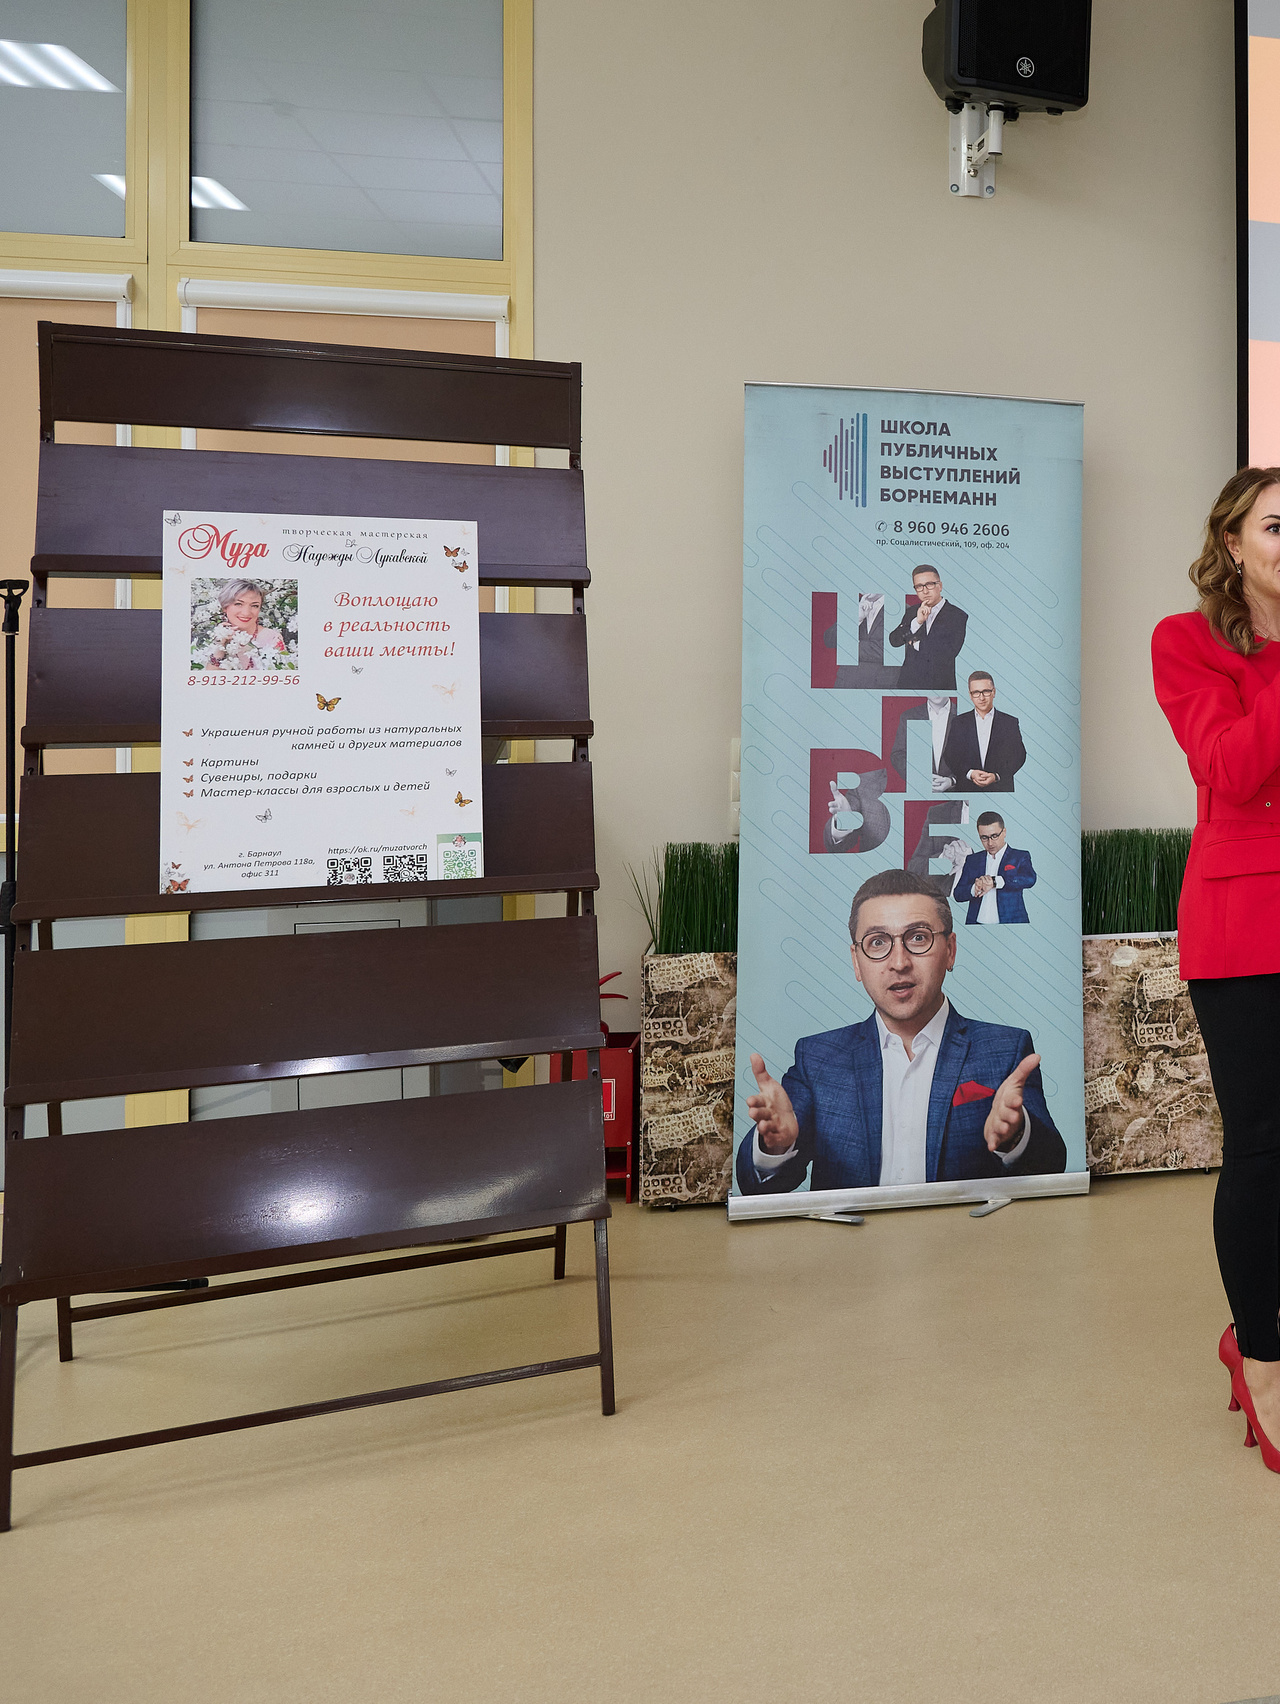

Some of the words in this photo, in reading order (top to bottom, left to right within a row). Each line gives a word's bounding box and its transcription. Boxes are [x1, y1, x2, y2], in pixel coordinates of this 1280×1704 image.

[880, 419, 952, 437] ШКОЛА
[880, 442, 998, 462] ПУБЛИЧНЫХ
[880, 465, 1021, 485] ВЫСТУПЛЕНИЙ
[880, 488, 997, 507] БОРНЕМАНН
[282, 528, 352, 537] творческая
[360, 530, 428, 540] мастерская
[893, 520, 903, 533] 8
[908, 521, 936, 534] 960
[941, 522, 969, 535] 946
[972, 523, 1010, 536] 2606
[178, 523, 269, 568] Муза
[980, 541, 994, 549] оф.
[282, 543, 353, 567] Надежды
[356, 546, 429, 568] Лукавской
[333, 591, 438, 611] Воплощаю
[324, 621, 333, 632] в
[338, 620, 451, 638] реальность
[324, 645, 374, 658] ваши
[379, 642, 455, 658] мечты!
[187, 674, 301, 687] 8-913-212-99-56
[200, 728, 269, 739] Украшения
[272, 726, 314, 738] ручной
[316, 725, 365, 737] работы
[384, 725, 462, 735] натуральных
[291, 740, 335, 750] камней
[348, 740, 387, 751] других
[389, 740, 462, 749] материалов
[200, 758, 259, 768] Картины
[200, 773, 263, 784] Сувениры,
[267, 771, 317, 781] подарки
[200, 787, 299, 798] Мастер-классы
[301, 785, 323, 795] для
[326, 784, 380, 795] взрослых
[393, 781, 430, 792] детей
[247, 850, 282, 858] Барнаул
[328, 843, 428, 855] https://ok.ru/muzatvorch
[254, 860, 292, 868] Петрова
[241, 871, 262, 879] офис
[264, 869, 279, 877] 311
